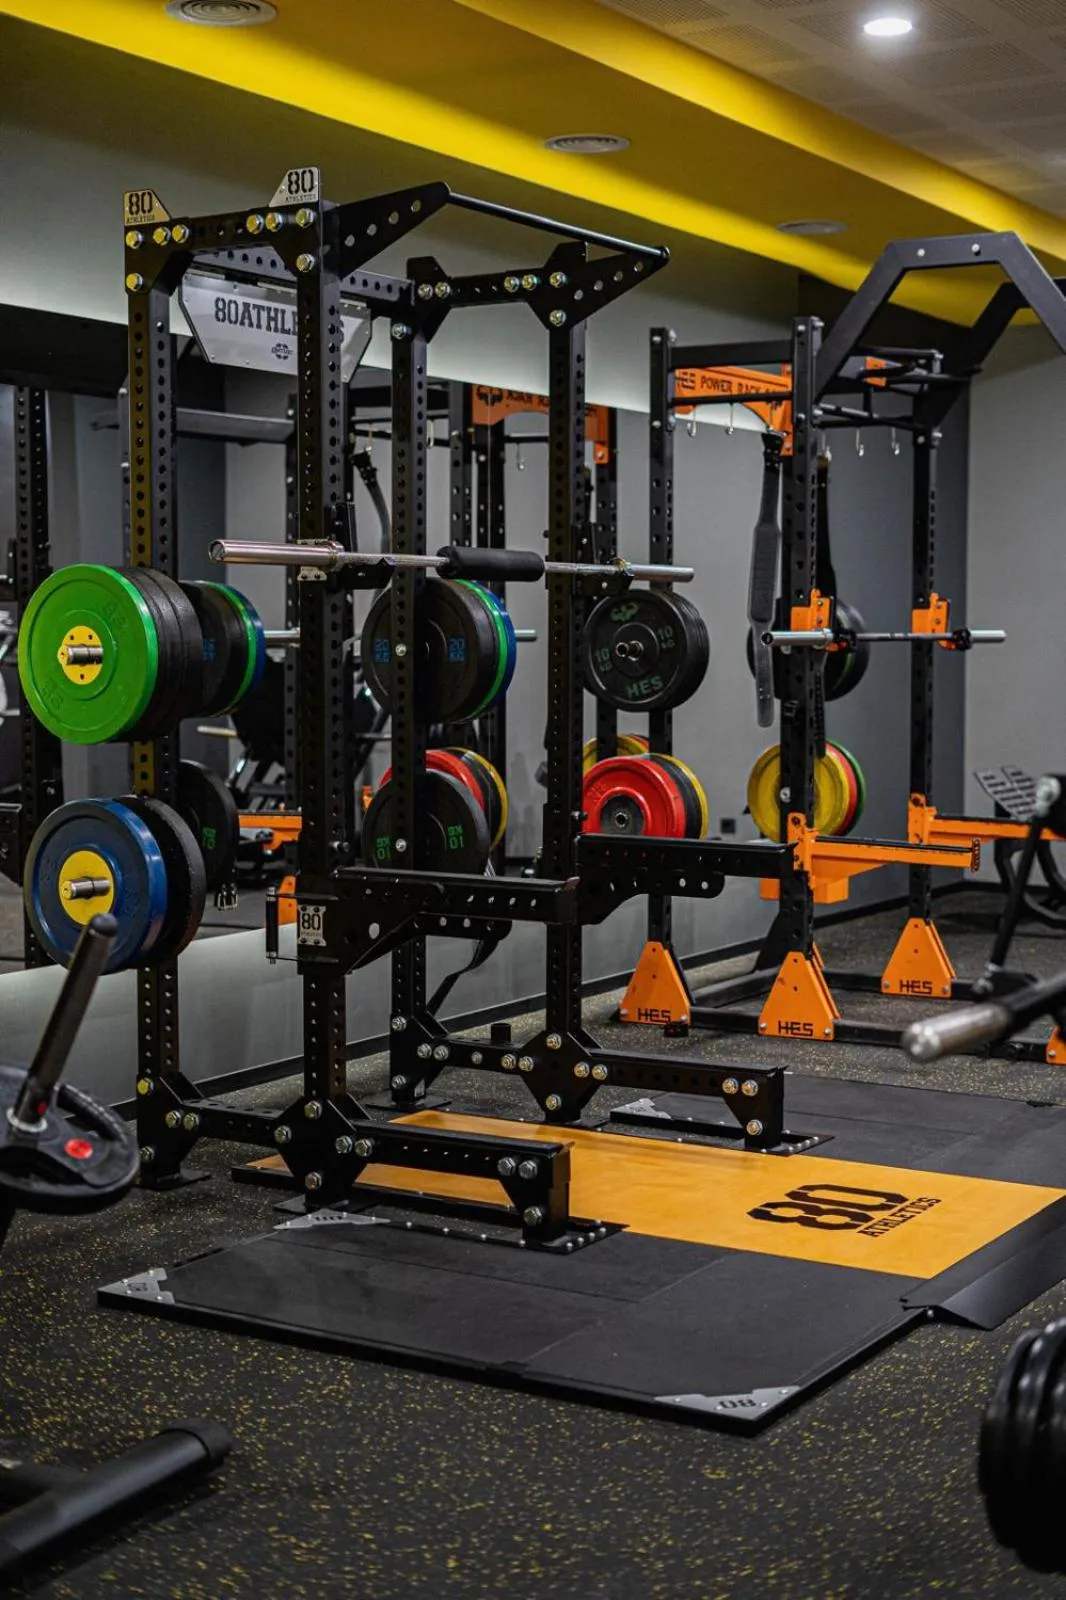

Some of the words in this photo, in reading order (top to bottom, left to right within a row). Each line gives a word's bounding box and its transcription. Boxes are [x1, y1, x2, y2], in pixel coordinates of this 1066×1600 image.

[287, 169, 314, 195] 80
[128, 191, 153, 216] 80
[700, 376, 733, 393] POWER
[658, 626, 674, 641] 10
[627, 676, 663, 699] HES
[301, 912, 321, 931] 80
[900, 979, 933, 995] HES
[637, 1008, 671, 1024] HES
[778, 1020, 814, 1037] HES
[746, 1184, 910, 1230] 80
[856, 1197, 942, 1238] ATHLETICS
